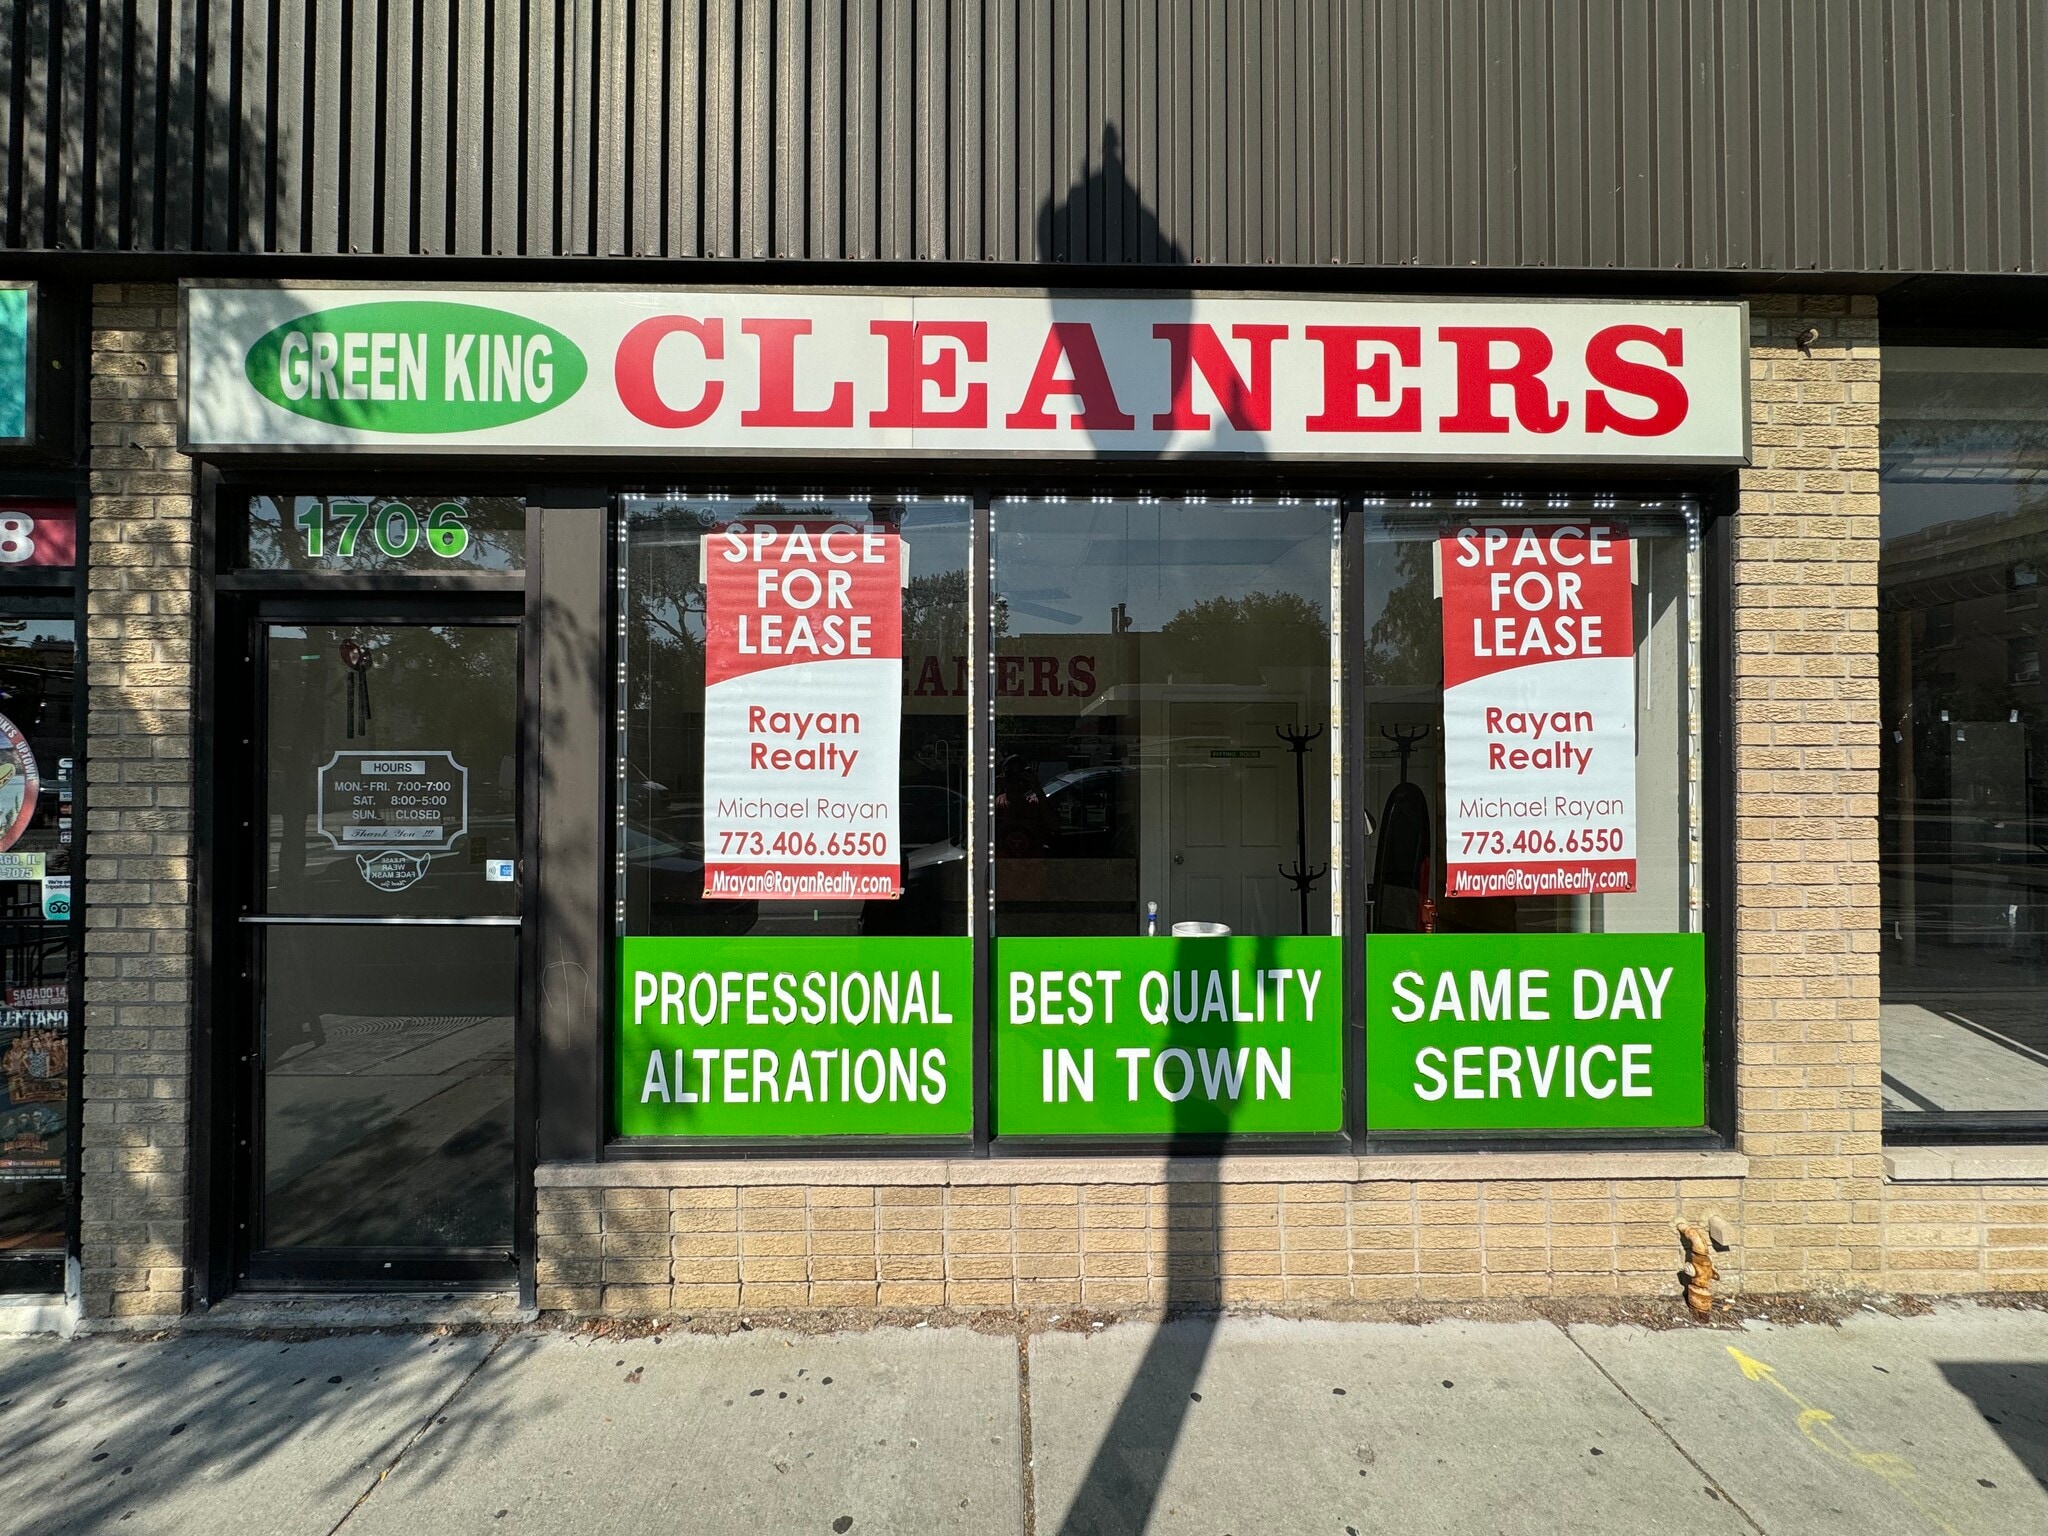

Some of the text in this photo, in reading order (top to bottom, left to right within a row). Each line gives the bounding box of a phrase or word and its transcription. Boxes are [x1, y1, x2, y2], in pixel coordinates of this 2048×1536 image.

[279, 331, 554, 404] GREEN KING
[614, 315, 1690, 438] CLEANERS
[0, 511, 35, 563] 8
[297, 502, 469, 558] 1706
[722, 523, 886, 564] SPACE
[1456, 526, 1613, 567] SPACE
[757, 568, 853, 610] FOR
[1490, 571, 1584, 612] FOR
[738, 614, 872, 656] LEASE
[1473, 615, 1602, 657] LEASE
[748, 705, 860, 741] Rayan
[1485, 706, 1594, 740] Rayan
[16, 741, 39, 781] UPTOWN
[373, 762, 413, 773] HOURS
[750, 742, 859, 778] Realty
[1488, 741, 1594, 776] Realty
[334, 781, 451, 792] MON.-FRI. 7:00-7:00
[353, 795, 447, 806] SAT. 8:00-5:00
[352, 809, 441, 820] SUN. CLOSED
[717, 797, 889, 824] Michael Rayan
[1458, 796, 1625, 821] Michael Rayan
[351, 828, 388, 838] Thank
[393, 829, 416, 838] You
[719, 831, 888, 857] 773.406.6550
[1461, 827, 1624, 856] 773.406.6550
[27, 855, 41, 865] IL.
[711, 870, 892, 897] Mrayan@RayanRealty.com
[1455, 867, 1630, 897] Mrayan@RayanRealty.com
[13, 986, 67, 1000] SABADO 14
[635, 970, 953, 1026] PROFESSIONAL
[1009, 969, 1322, 1026] BEST QUALITY
[1391, 967, 1673, 1023] SAME DAY
[640, 1047, 947, 1105] ALTERATIONS
[1042, 1047, 1291, 1103] IN TOWN
[1414, 1043, 1653, 1101] SERVICE
